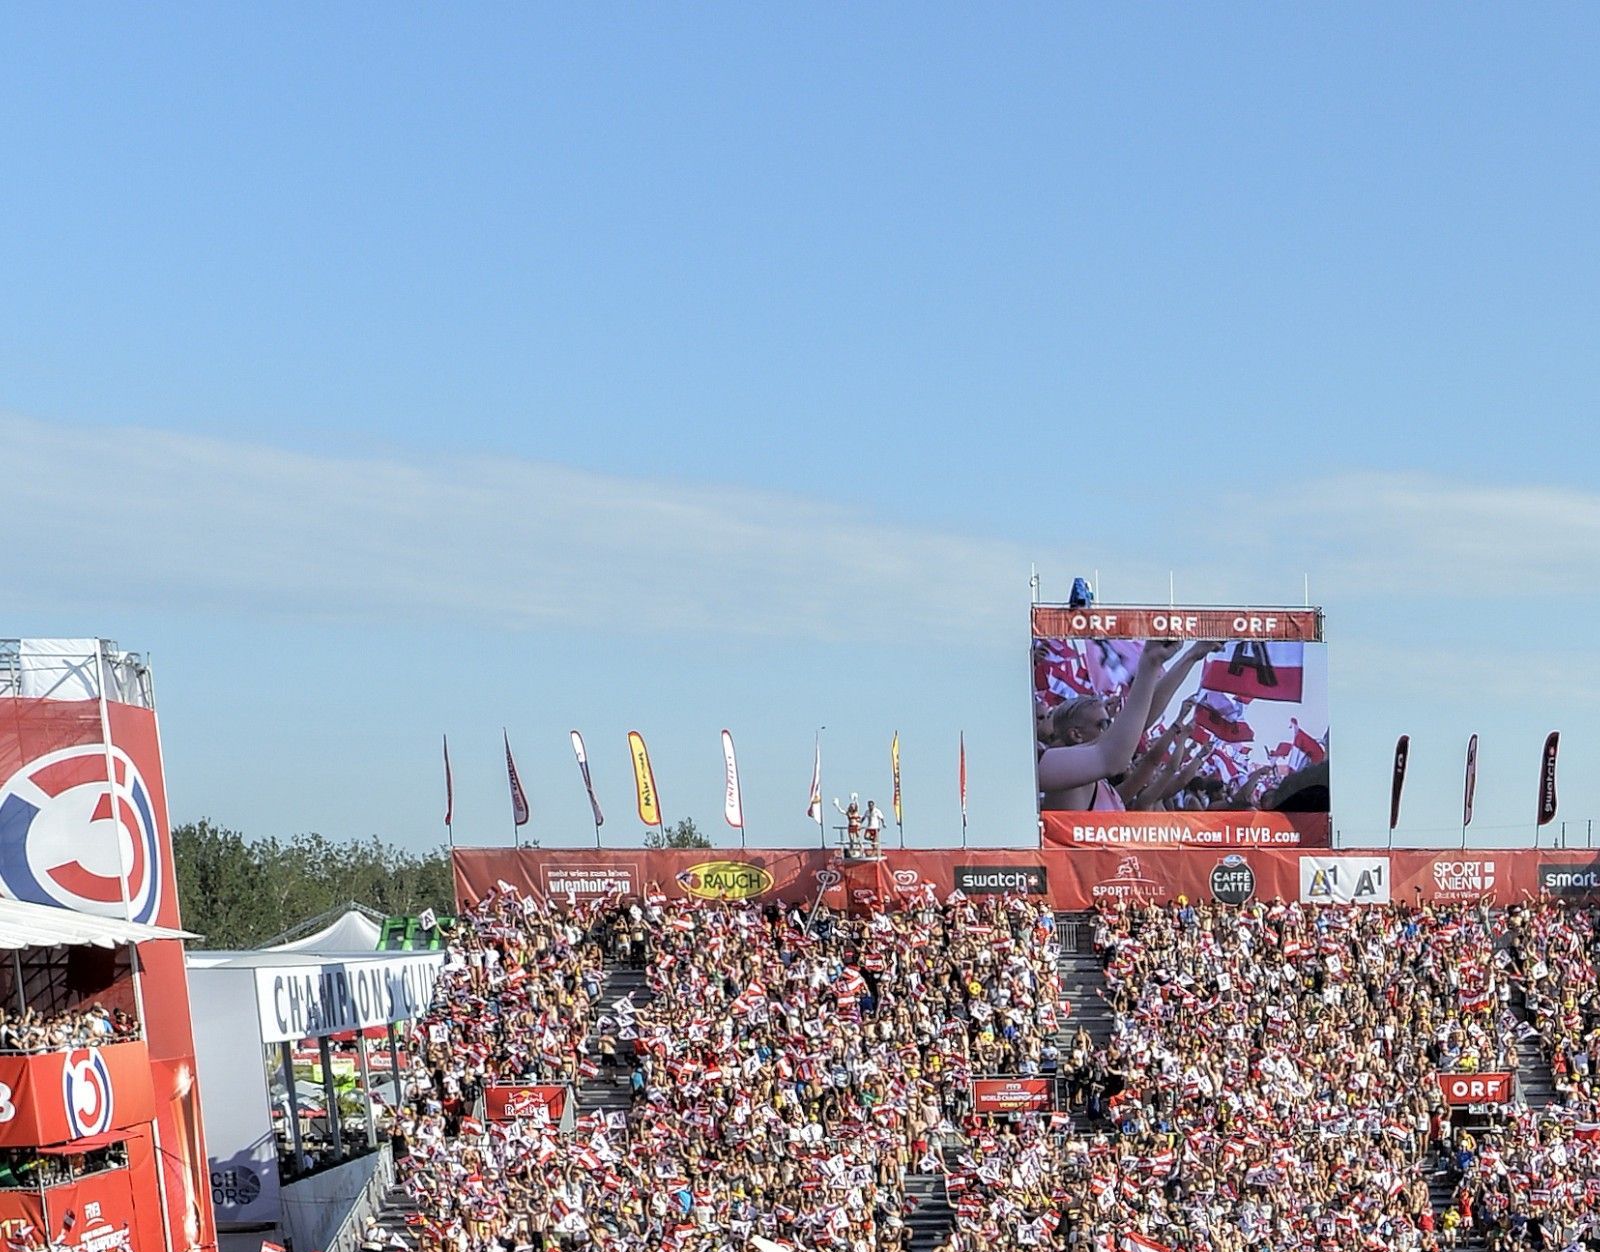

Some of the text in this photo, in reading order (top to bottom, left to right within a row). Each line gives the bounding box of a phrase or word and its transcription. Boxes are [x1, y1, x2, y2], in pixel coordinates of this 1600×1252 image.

[1072, 616, 1117, 630] ORF
[1153, 617, 1198, 631] ORF
[1233, 617, 1278, 632] ORF
[1213, 870, 1250, 882] CAFFÈ
[1433, 861, 1480, 877] SPORT
[703, 873, 762, 889] RAUCH
[962, 872, 1027, 889] swatch
[1434, 877, 1474, 891] WIEN
[1545, 870, 1597, 888] smart
[1092, 885, 1165, 896] SPORTHALLE
[1213, 882, 1250, 893] LATTE
[274, 966, 395, 1035] CHAMPIONS
[1452, 1081, 1500, 1097] ORF
